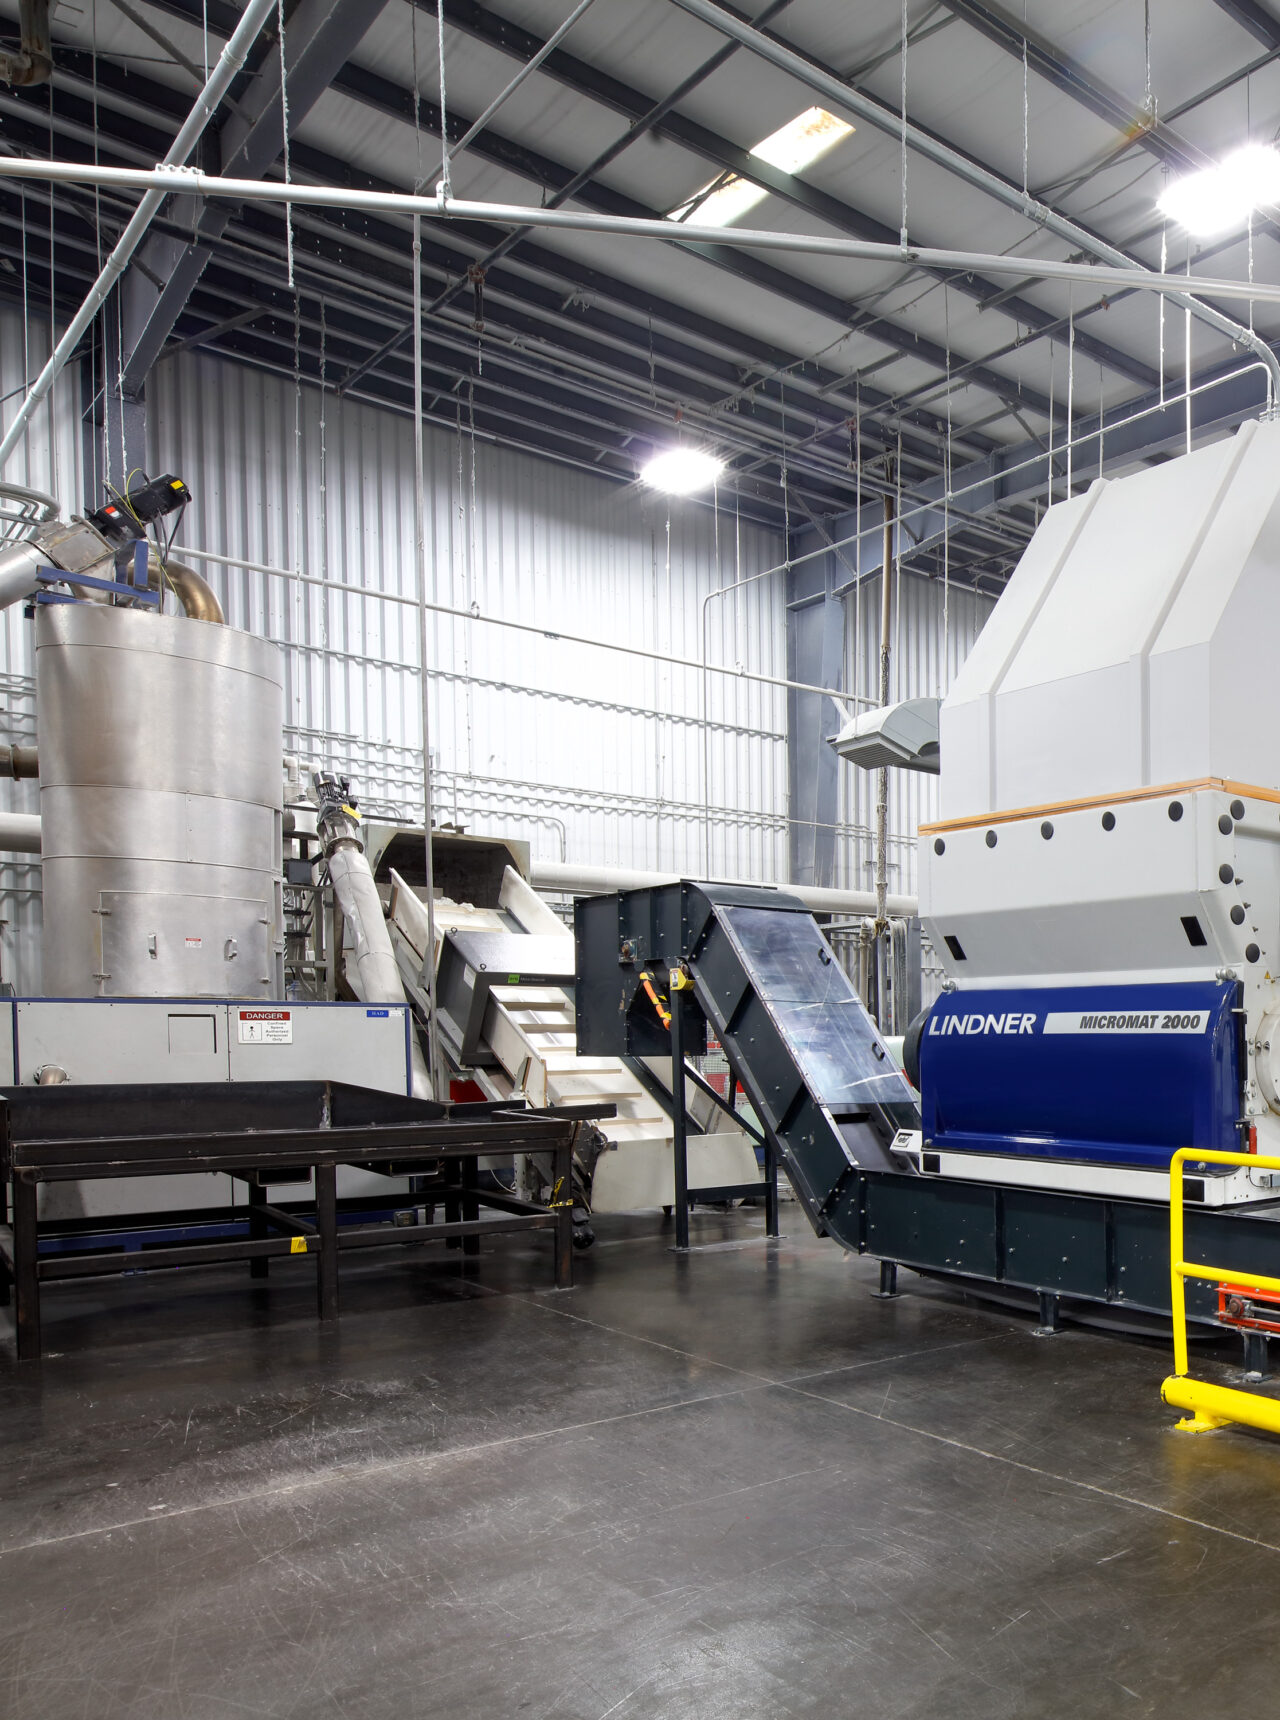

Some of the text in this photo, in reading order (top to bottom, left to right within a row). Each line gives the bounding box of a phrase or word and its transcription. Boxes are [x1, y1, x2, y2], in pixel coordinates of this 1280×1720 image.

[928, 1012, 1202, 1036] LINDNER MICROMAT 2000
